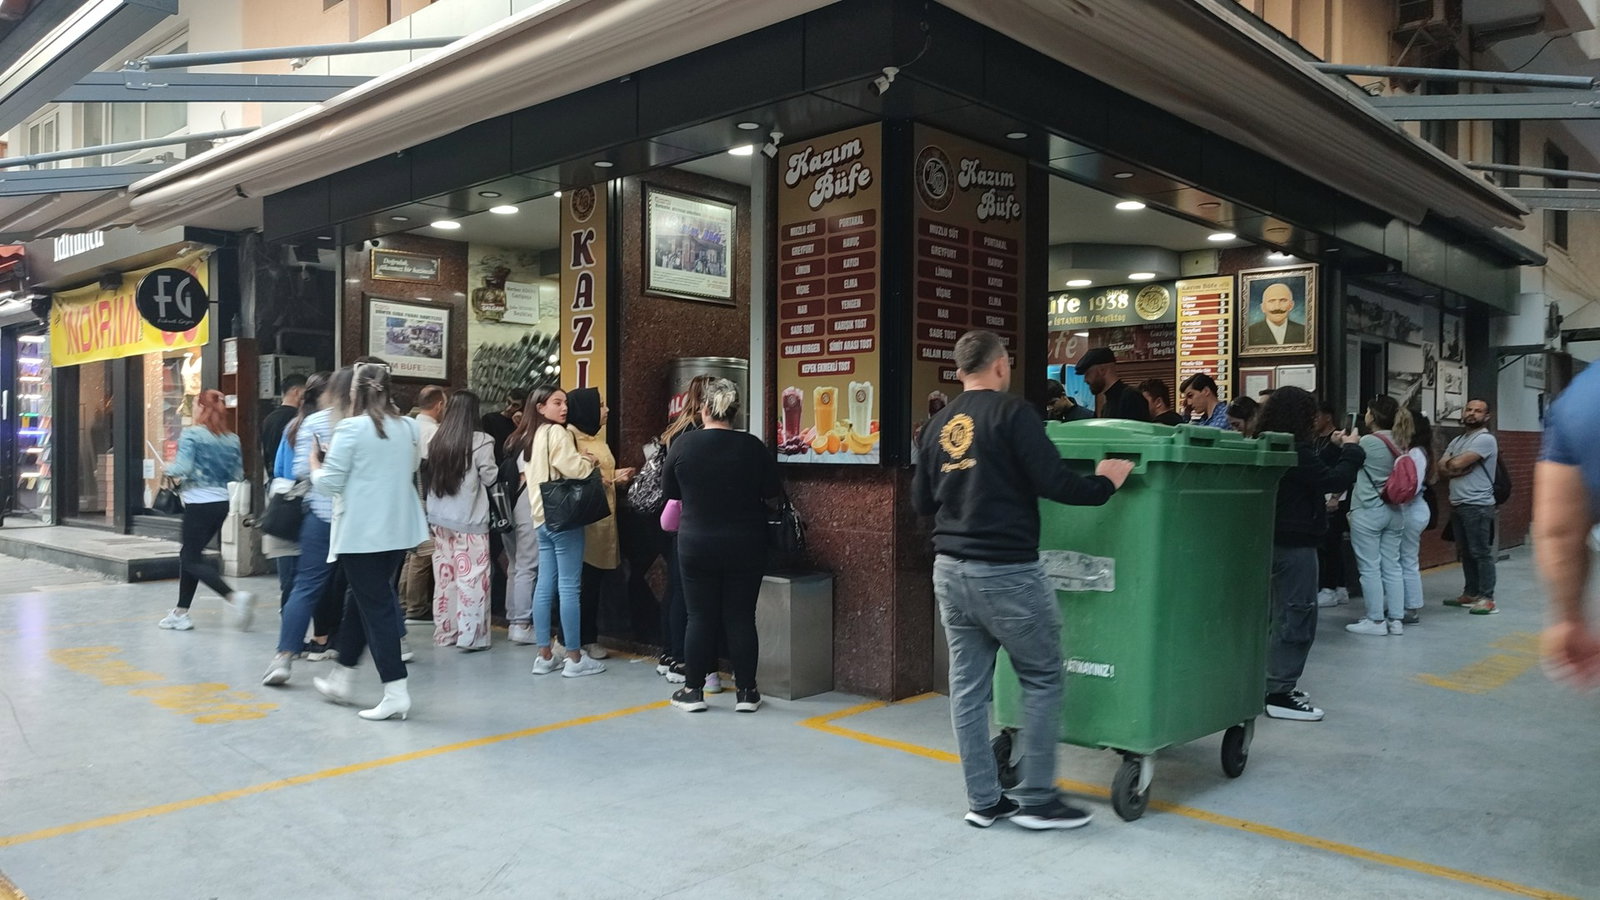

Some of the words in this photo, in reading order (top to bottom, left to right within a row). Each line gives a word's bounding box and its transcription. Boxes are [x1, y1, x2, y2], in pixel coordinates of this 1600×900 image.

[785, 138, 862, 186] Kazım
[958, 158, 1015, 188] Kazım
[809, 163, 871, 209] Büfe
[977, 188, 1021, 220] Büfe
[1088, 293, 1129, 311] 1938
